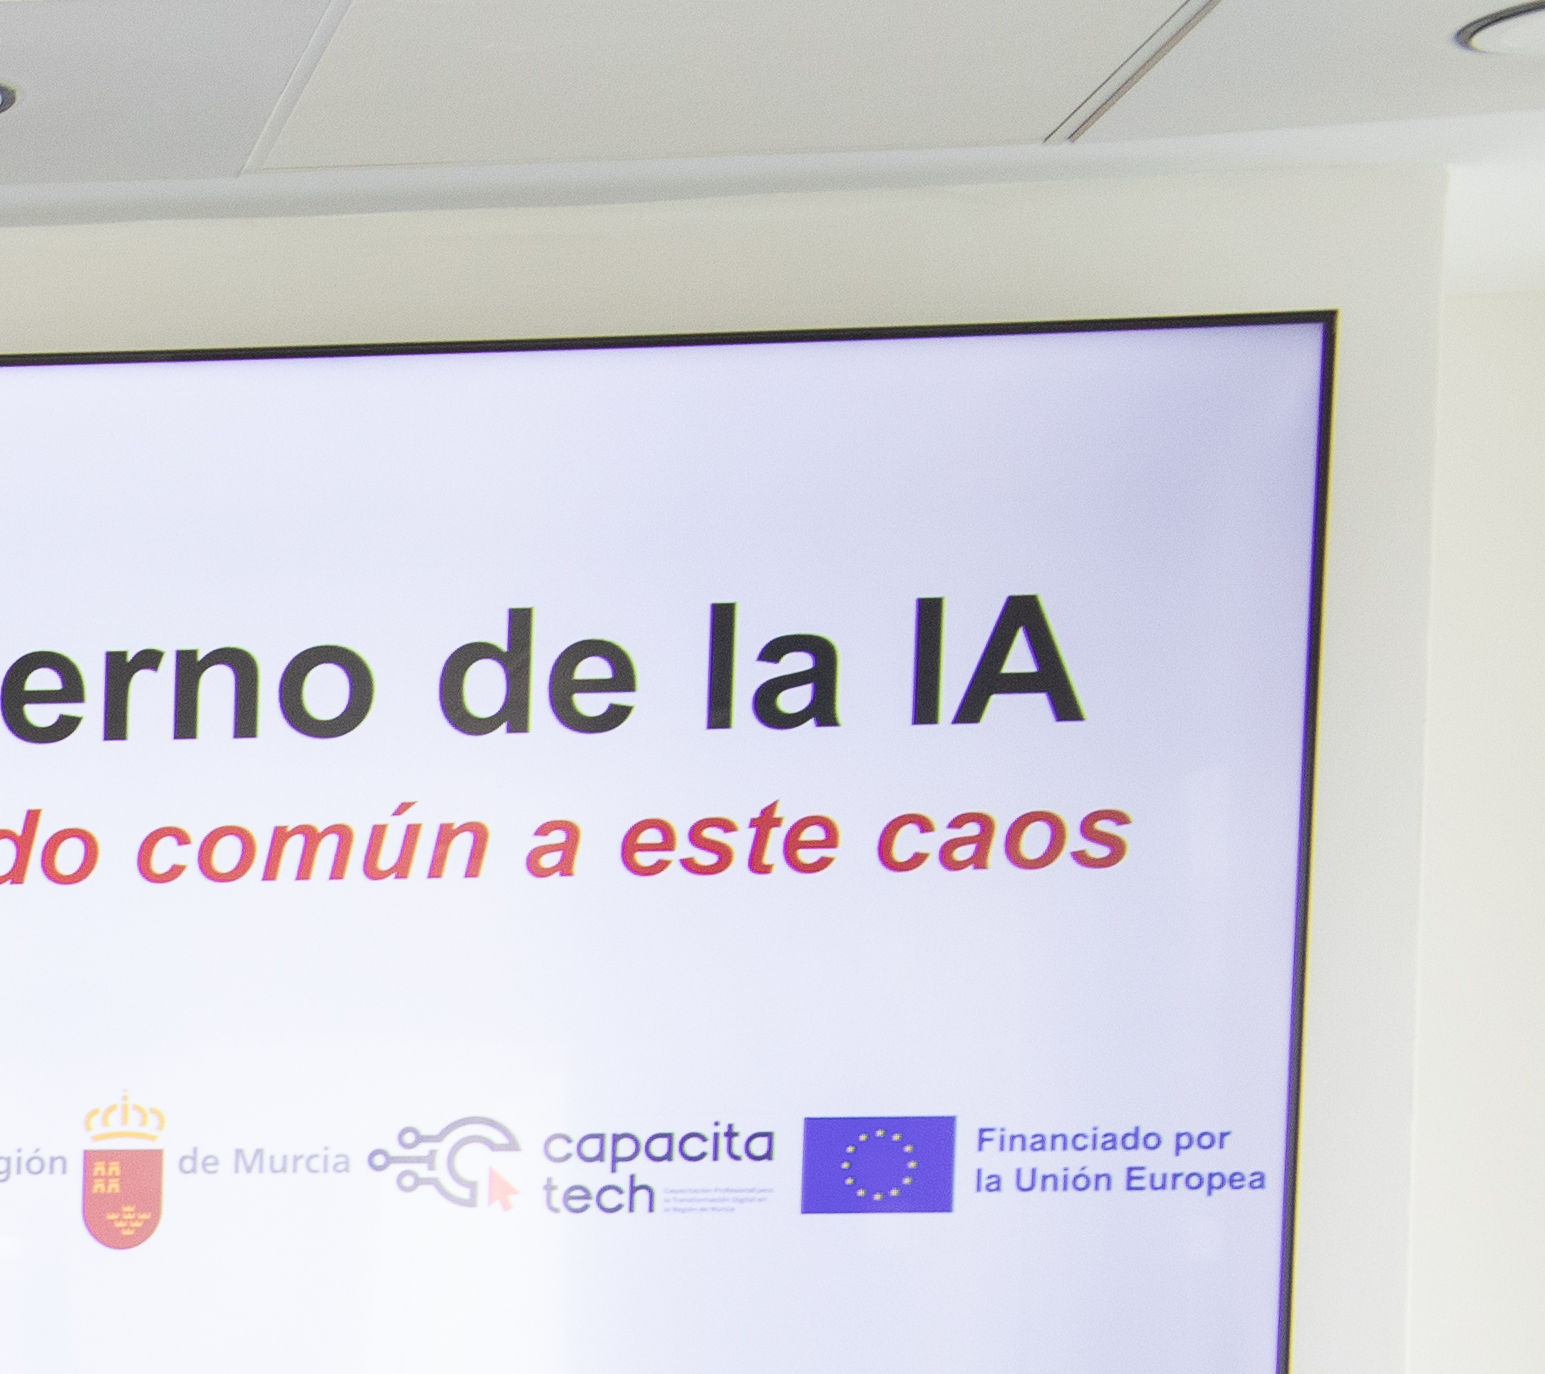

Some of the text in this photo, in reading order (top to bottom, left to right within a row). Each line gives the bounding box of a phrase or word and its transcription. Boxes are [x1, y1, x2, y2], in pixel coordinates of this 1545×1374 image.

[437, 606, 638, 736] de
[705, 602, 842, 731] la
[911, 594, 1086, 726] IA
[135, 800, 490, 884] común
[524, 818, 582, 878] a
[618, 798, 840, 877] este
[876, 808, 1132, 873] caos
[178, 1145, 221, 1176] de
[233, 1145, 352, 1176] Murcia
[543, 1121, 775, 1173] capacita
[976, 1125, 1232, 1157] Financiado por
[543, 1173, 655, 1214] tech
[975, 1164, 1266, 1197] la Unión Europea
